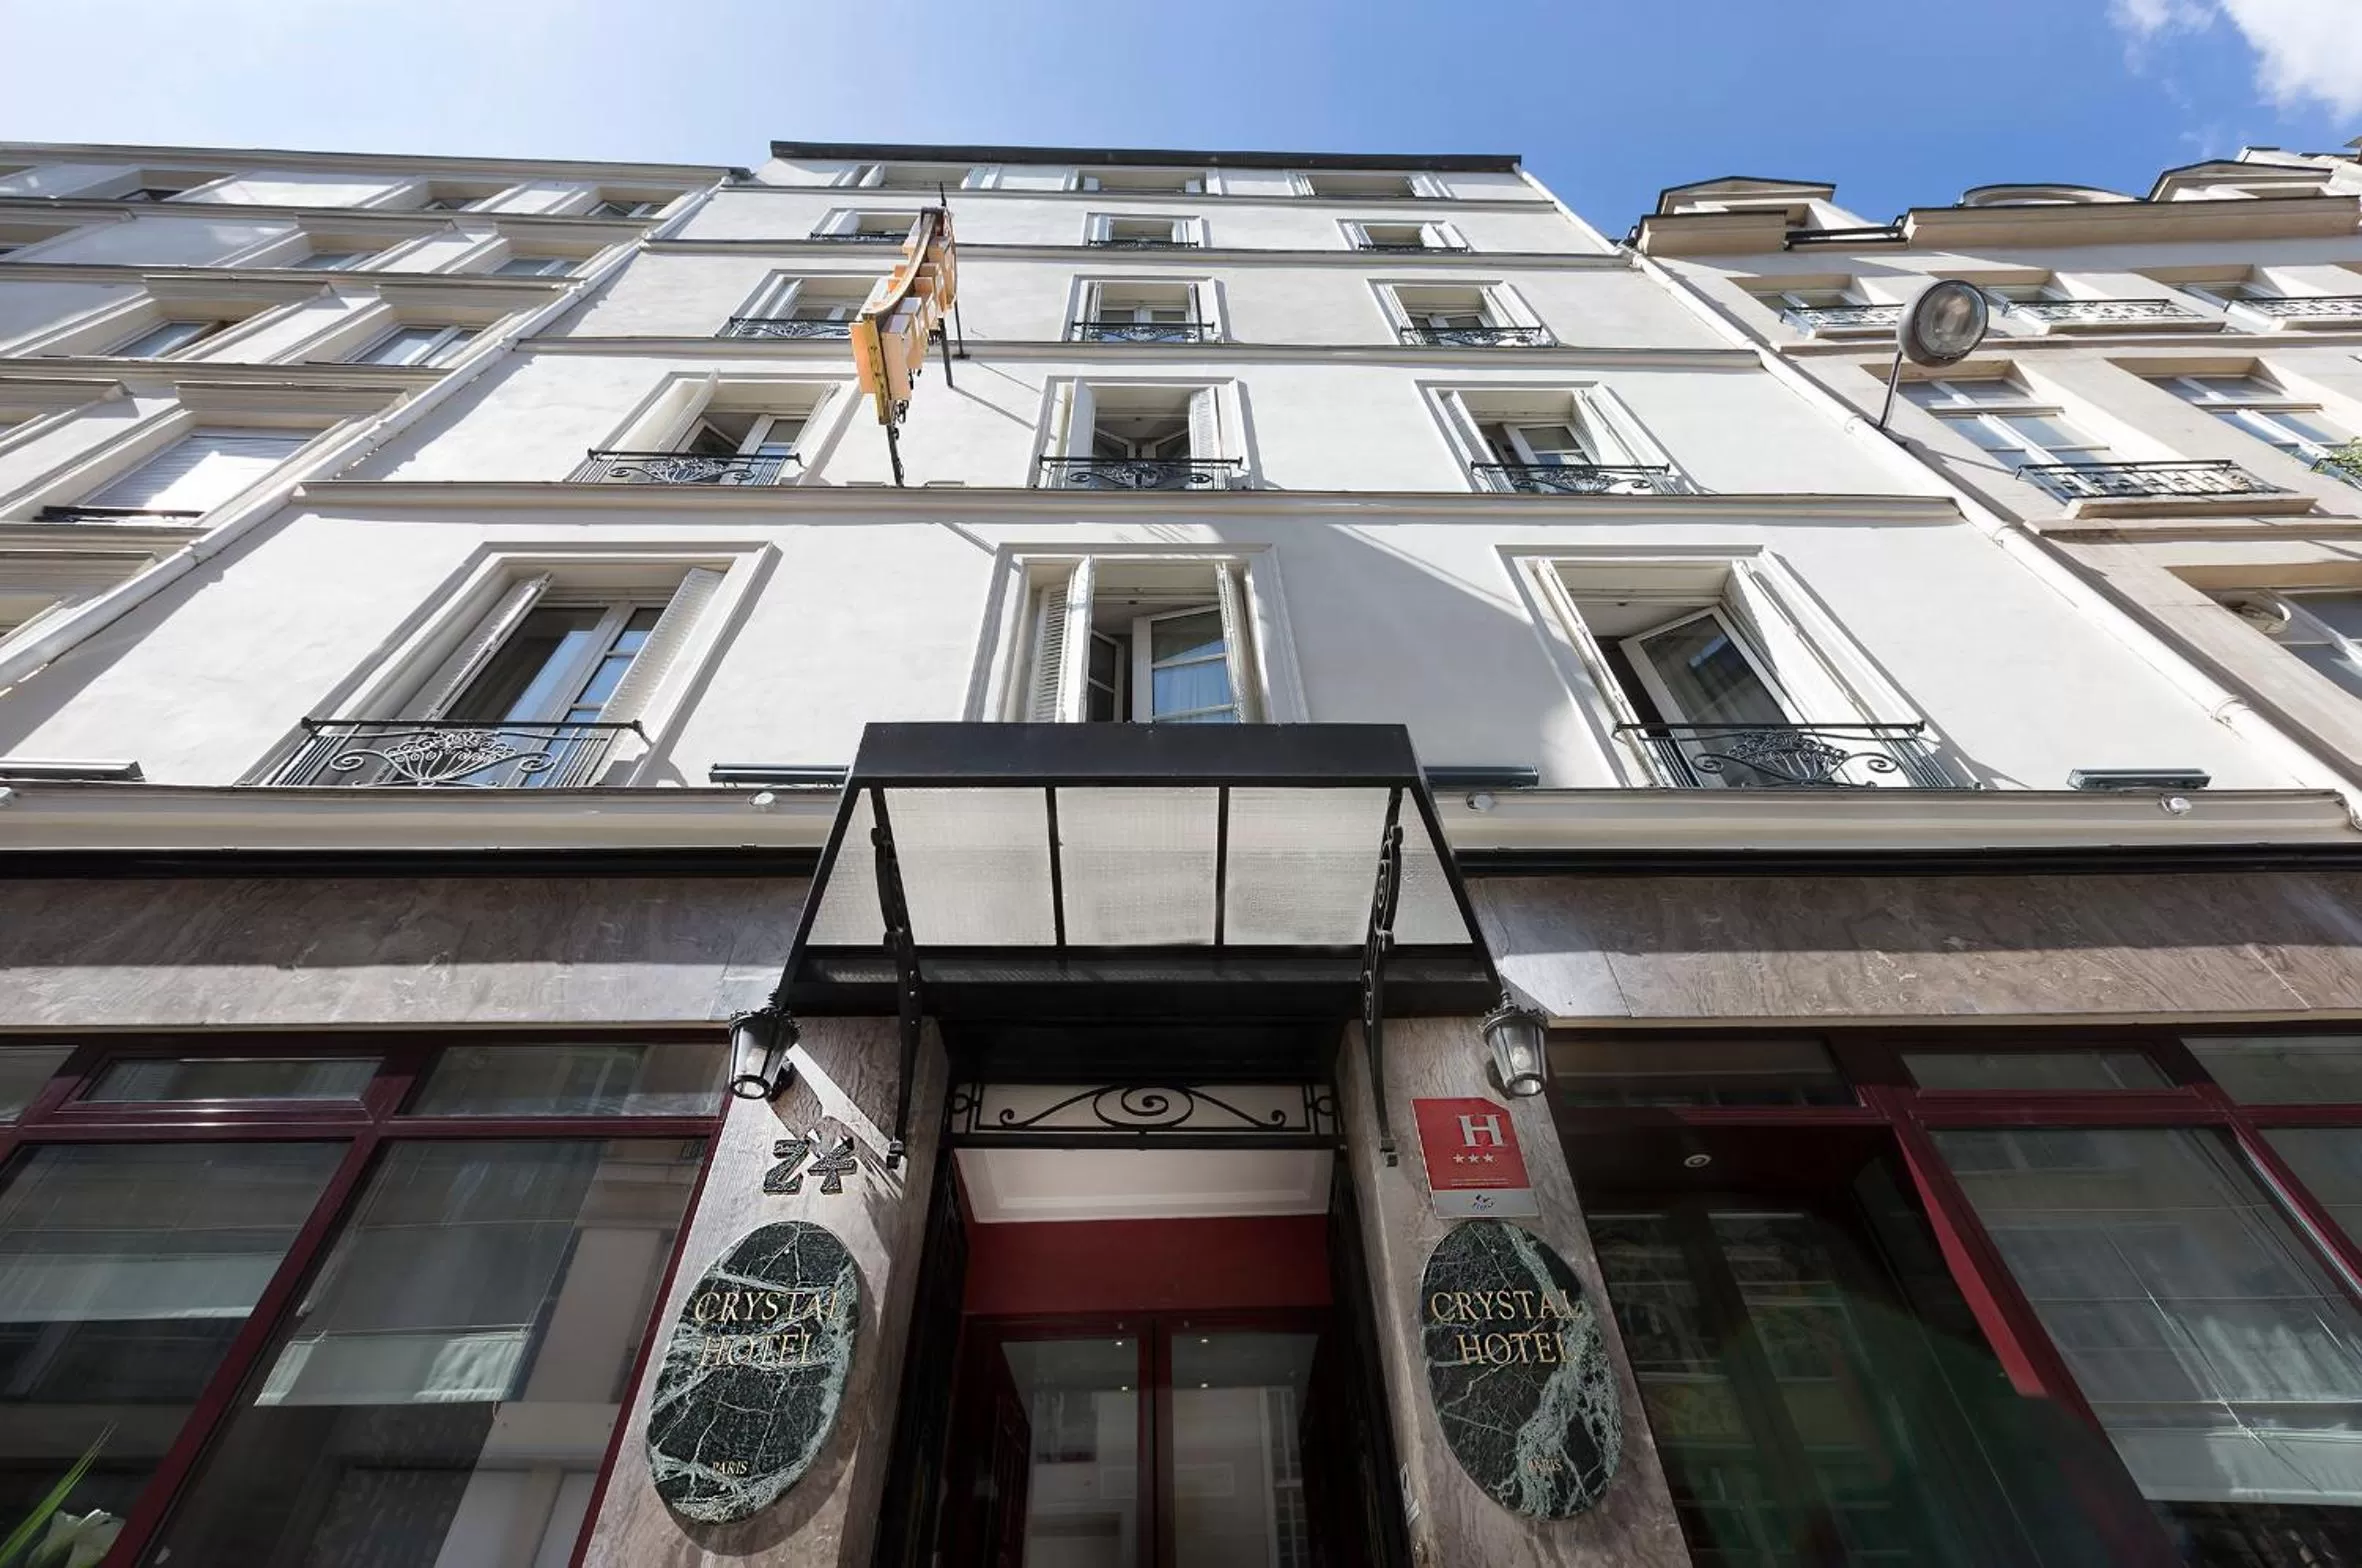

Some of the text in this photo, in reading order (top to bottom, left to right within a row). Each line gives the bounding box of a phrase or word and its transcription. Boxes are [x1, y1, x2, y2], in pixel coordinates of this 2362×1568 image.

[1456, 1113, 1507, 1148] H
[763, 1134, 858, 1195] 24
[694, 1290, 841, 1323] CRYSTAL
[1431, 1289, 1583, 1321] CRYSTAL
[700, 1333, 813, 1366] HOTEL
[1456, 1332, 1576, 1365] HOTEL
